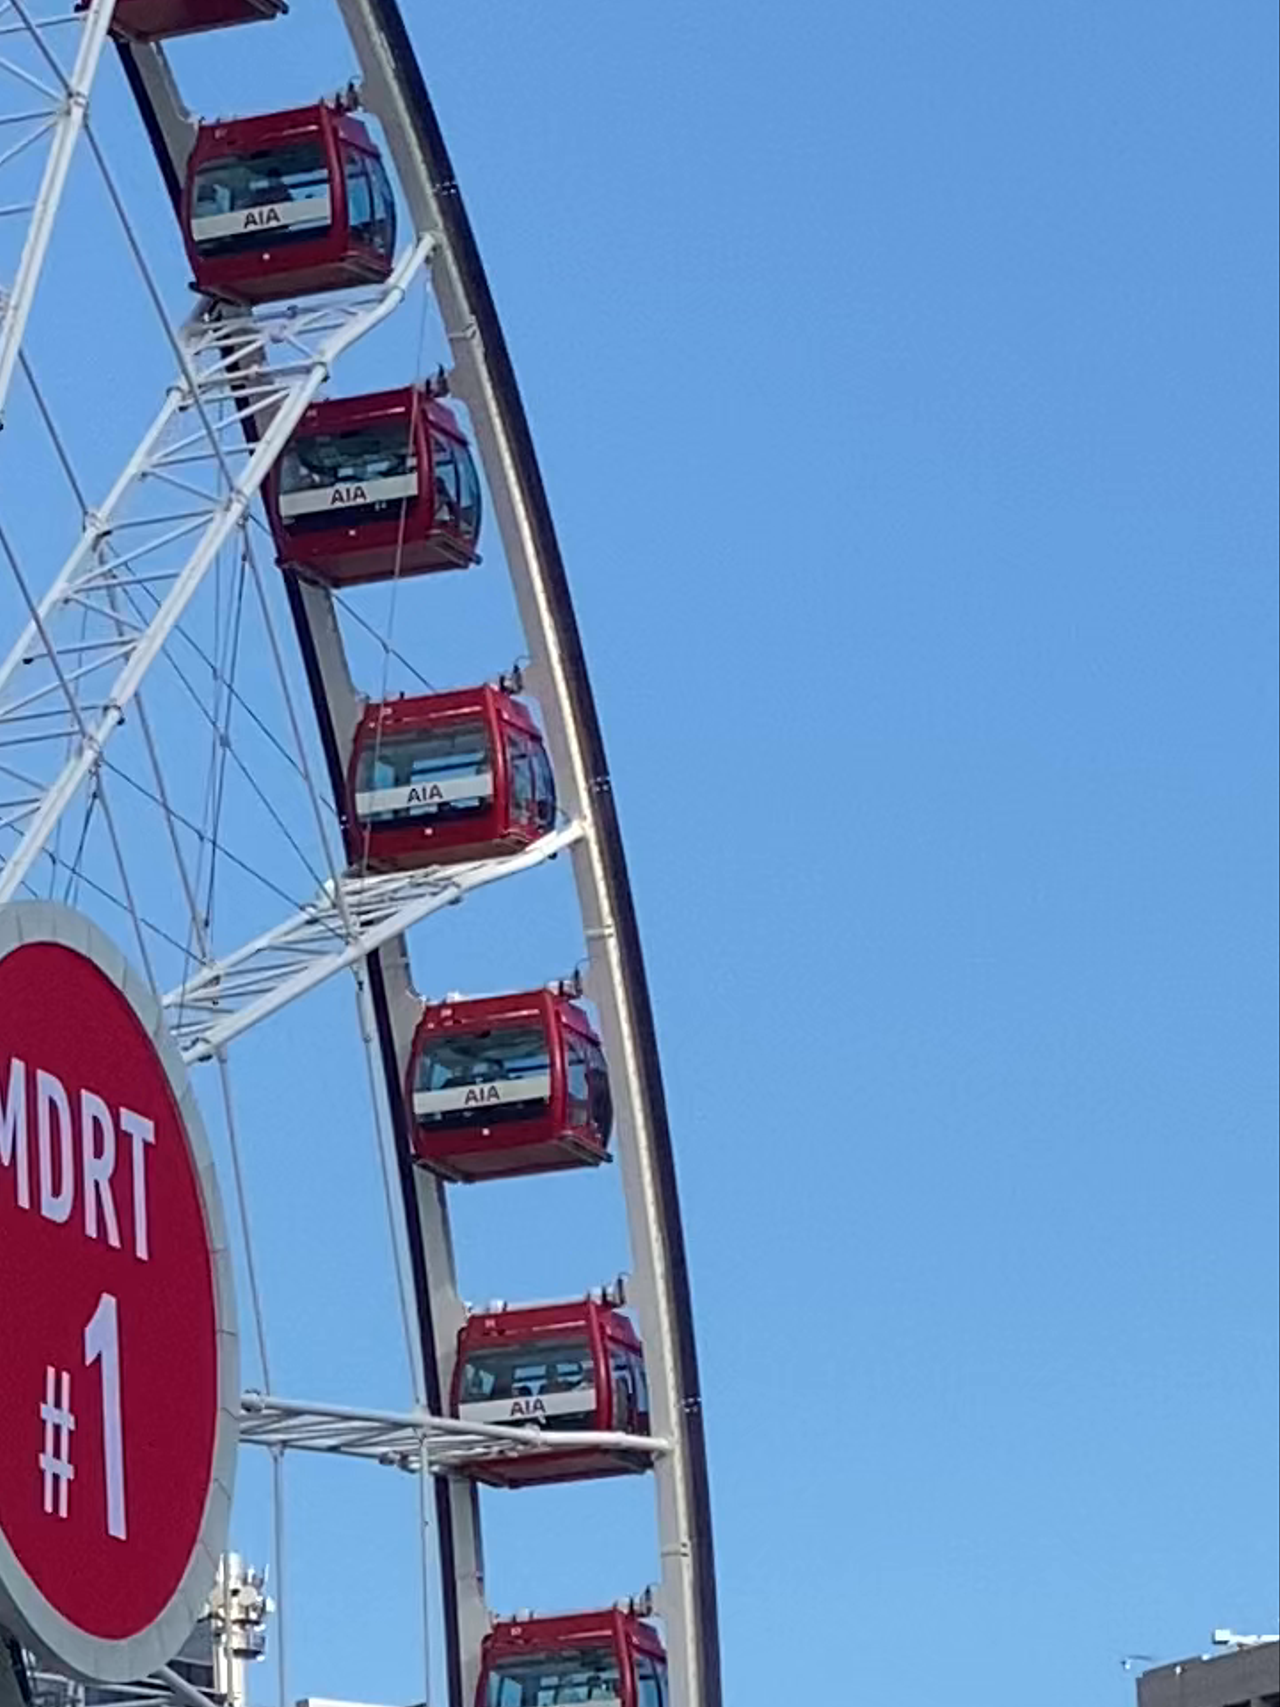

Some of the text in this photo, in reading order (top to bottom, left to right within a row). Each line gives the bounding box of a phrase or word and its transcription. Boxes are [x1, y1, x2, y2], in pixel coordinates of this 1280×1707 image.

[243, 205, 282, 229] AIA
[330, 483, 367, 506] AIA
[406, 782, 444, 806] AIA
[464, 1084, 500, 1105] AIA
[38, 1292, 128, 1542] #1
[510, 1397, 547, 1418] AIA
